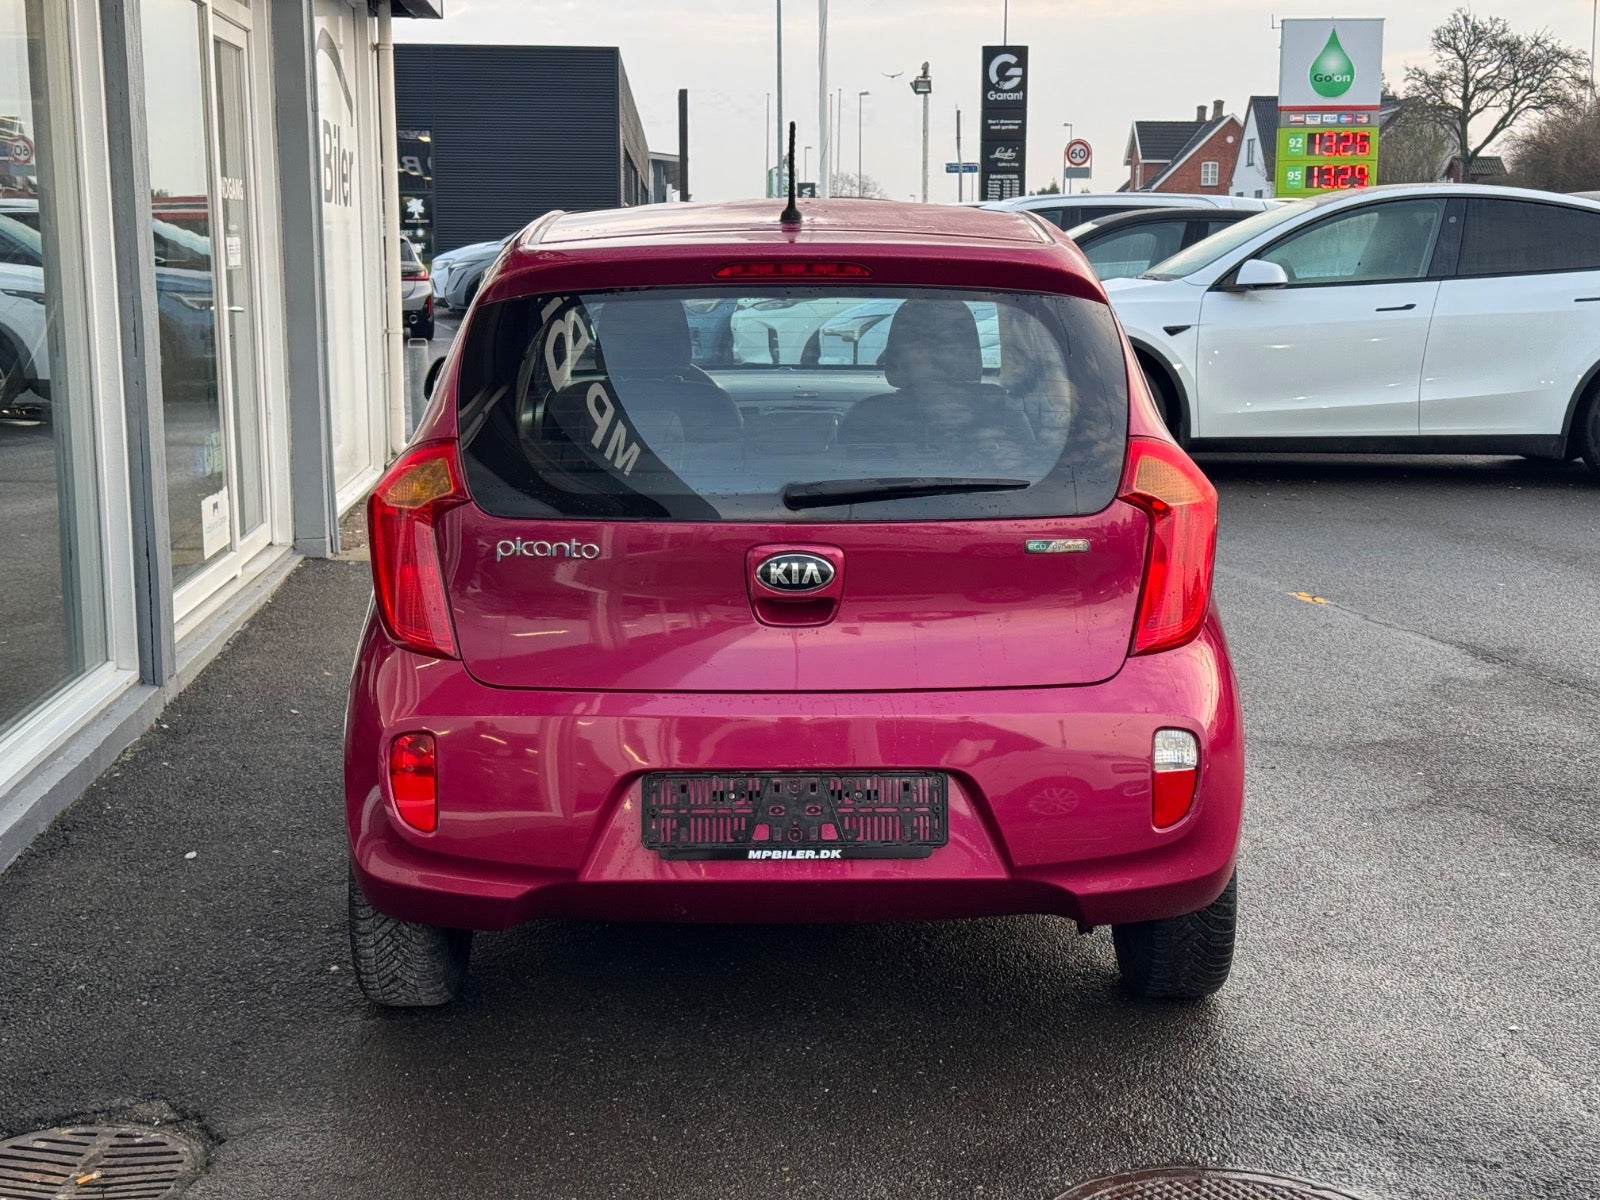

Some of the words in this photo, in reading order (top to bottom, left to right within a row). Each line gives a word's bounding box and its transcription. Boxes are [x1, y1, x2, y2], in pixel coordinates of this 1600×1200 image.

[1313, 72, 1351, 83] Go'on
[987, 90, 1024, 101] Garant
[1288, 138, 1303, 148] 92
[1070, 148, 1086, 159] 60
[322, 118, 354, 207] Biler
[1287, 171, 1301, 181] 95
[496, 536, 600, 562] picanto
[769, 562, 822, 584] KIA
[748, 849, 841, 859] MPBILER.DK
